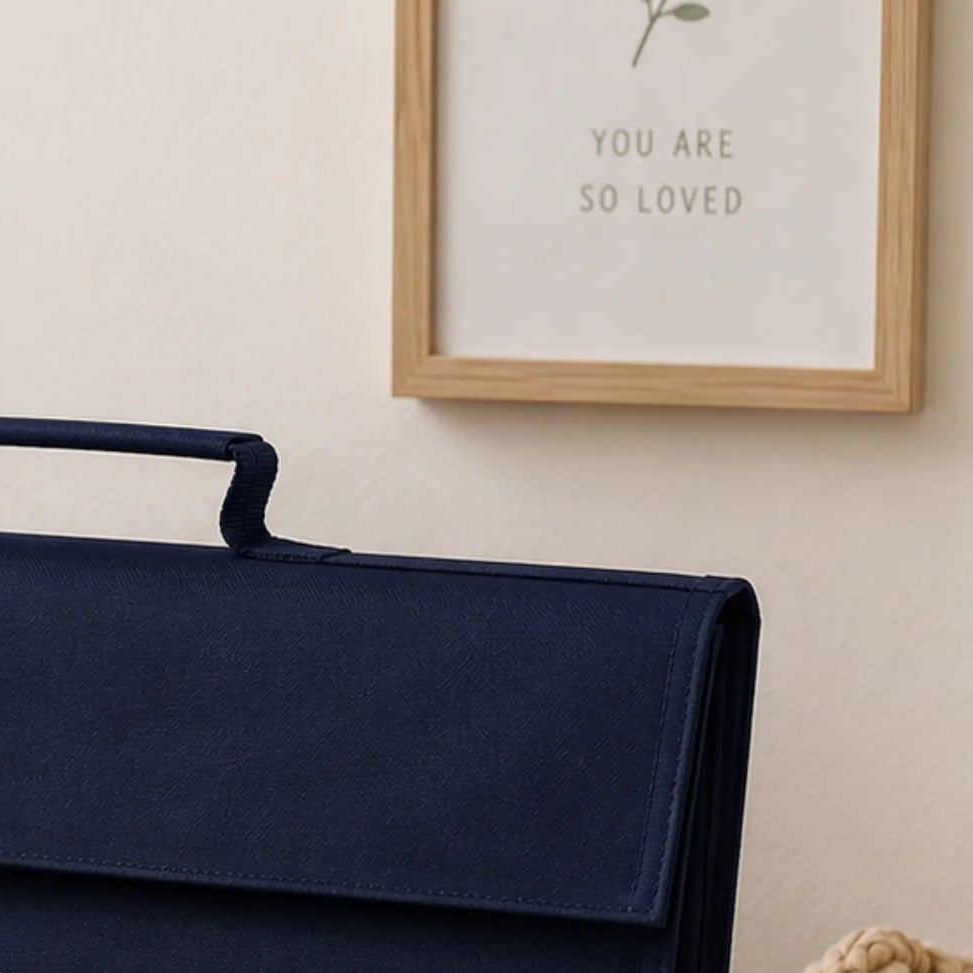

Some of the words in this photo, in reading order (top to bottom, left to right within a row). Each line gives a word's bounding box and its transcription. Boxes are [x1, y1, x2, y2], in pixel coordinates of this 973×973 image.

[591, 128, 654, 158] YOU
[672, 129, 733, 159] ARE
[580, 183, 618, 213] SO
[638, 185, 743, 215] LOVED
